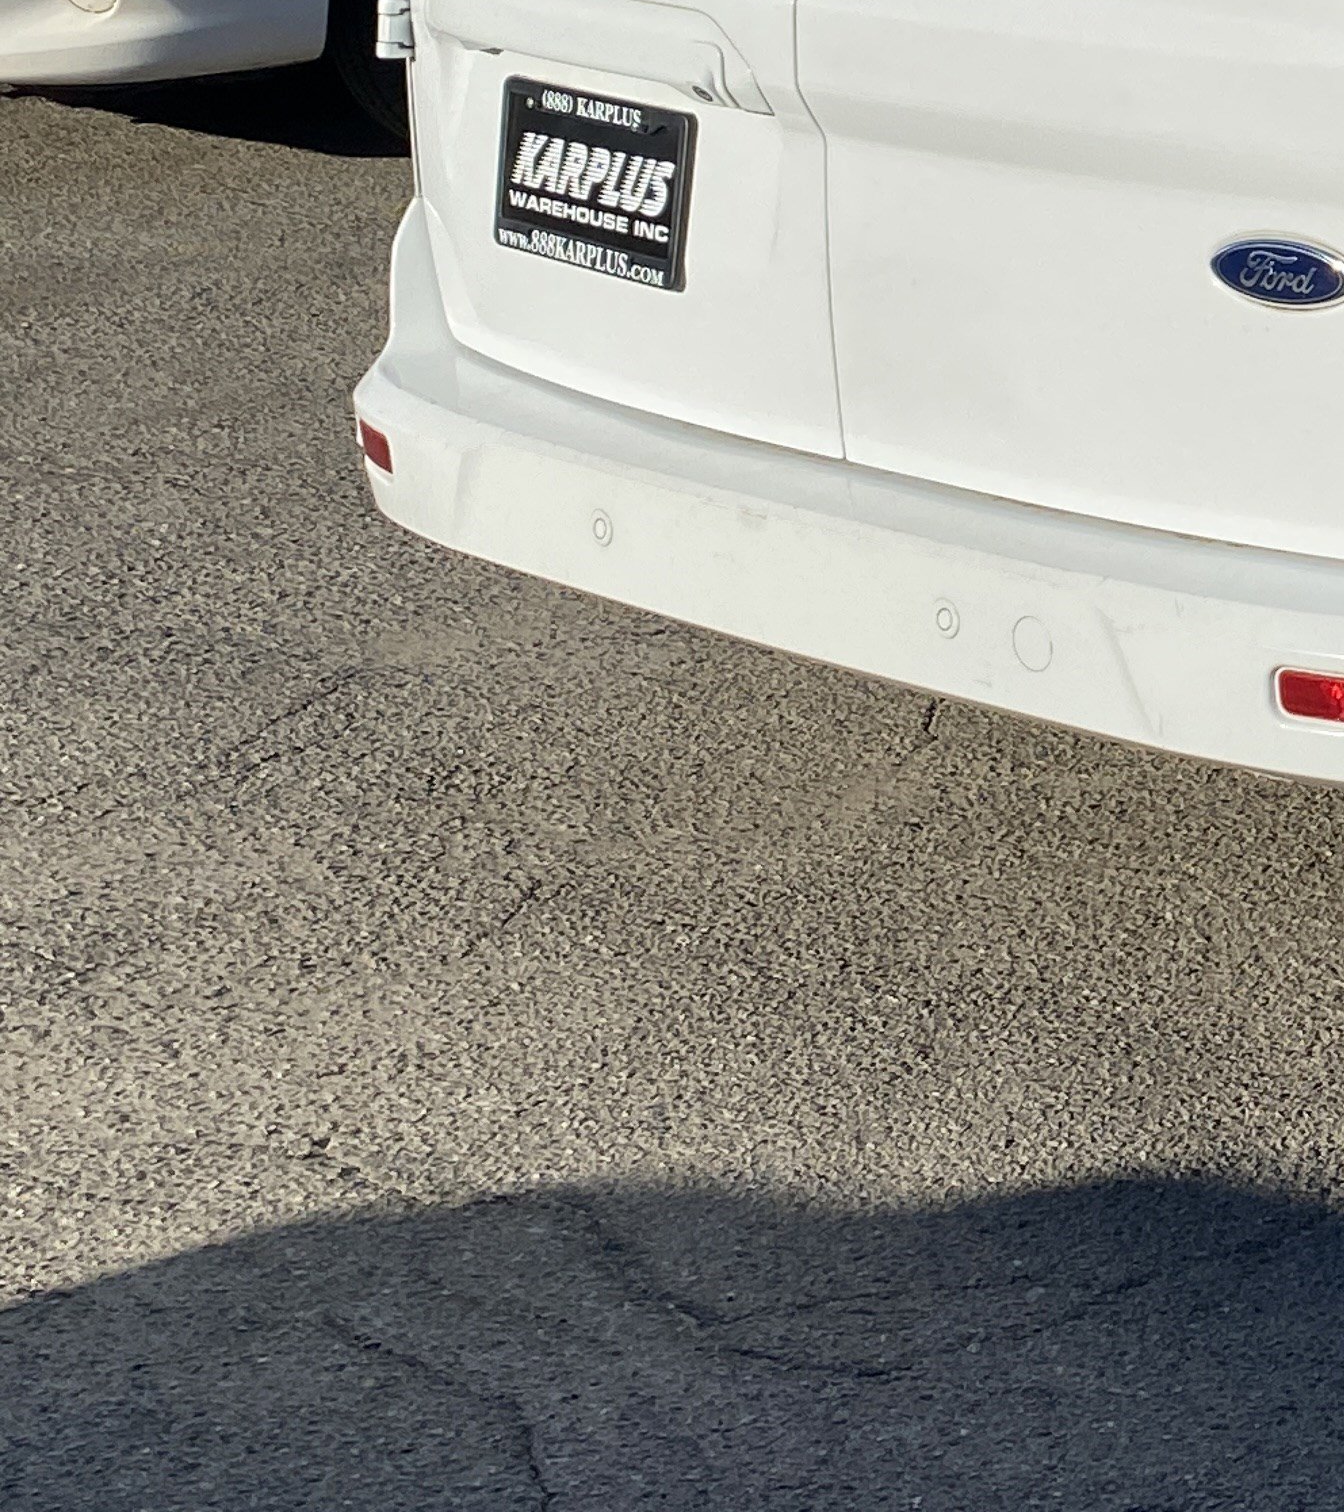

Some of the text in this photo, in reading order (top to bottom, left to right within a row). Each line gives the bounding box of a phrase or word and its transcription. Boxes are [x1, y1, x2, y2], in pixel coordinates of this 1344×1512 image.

[542, 89, 642, 127] (888) KARPLUS
[510, 131, 676, 217] KARPLUS
[508, 189, 669, 243] WAREHOUSE INC
[1240, 250, 1318, 294] Ford
